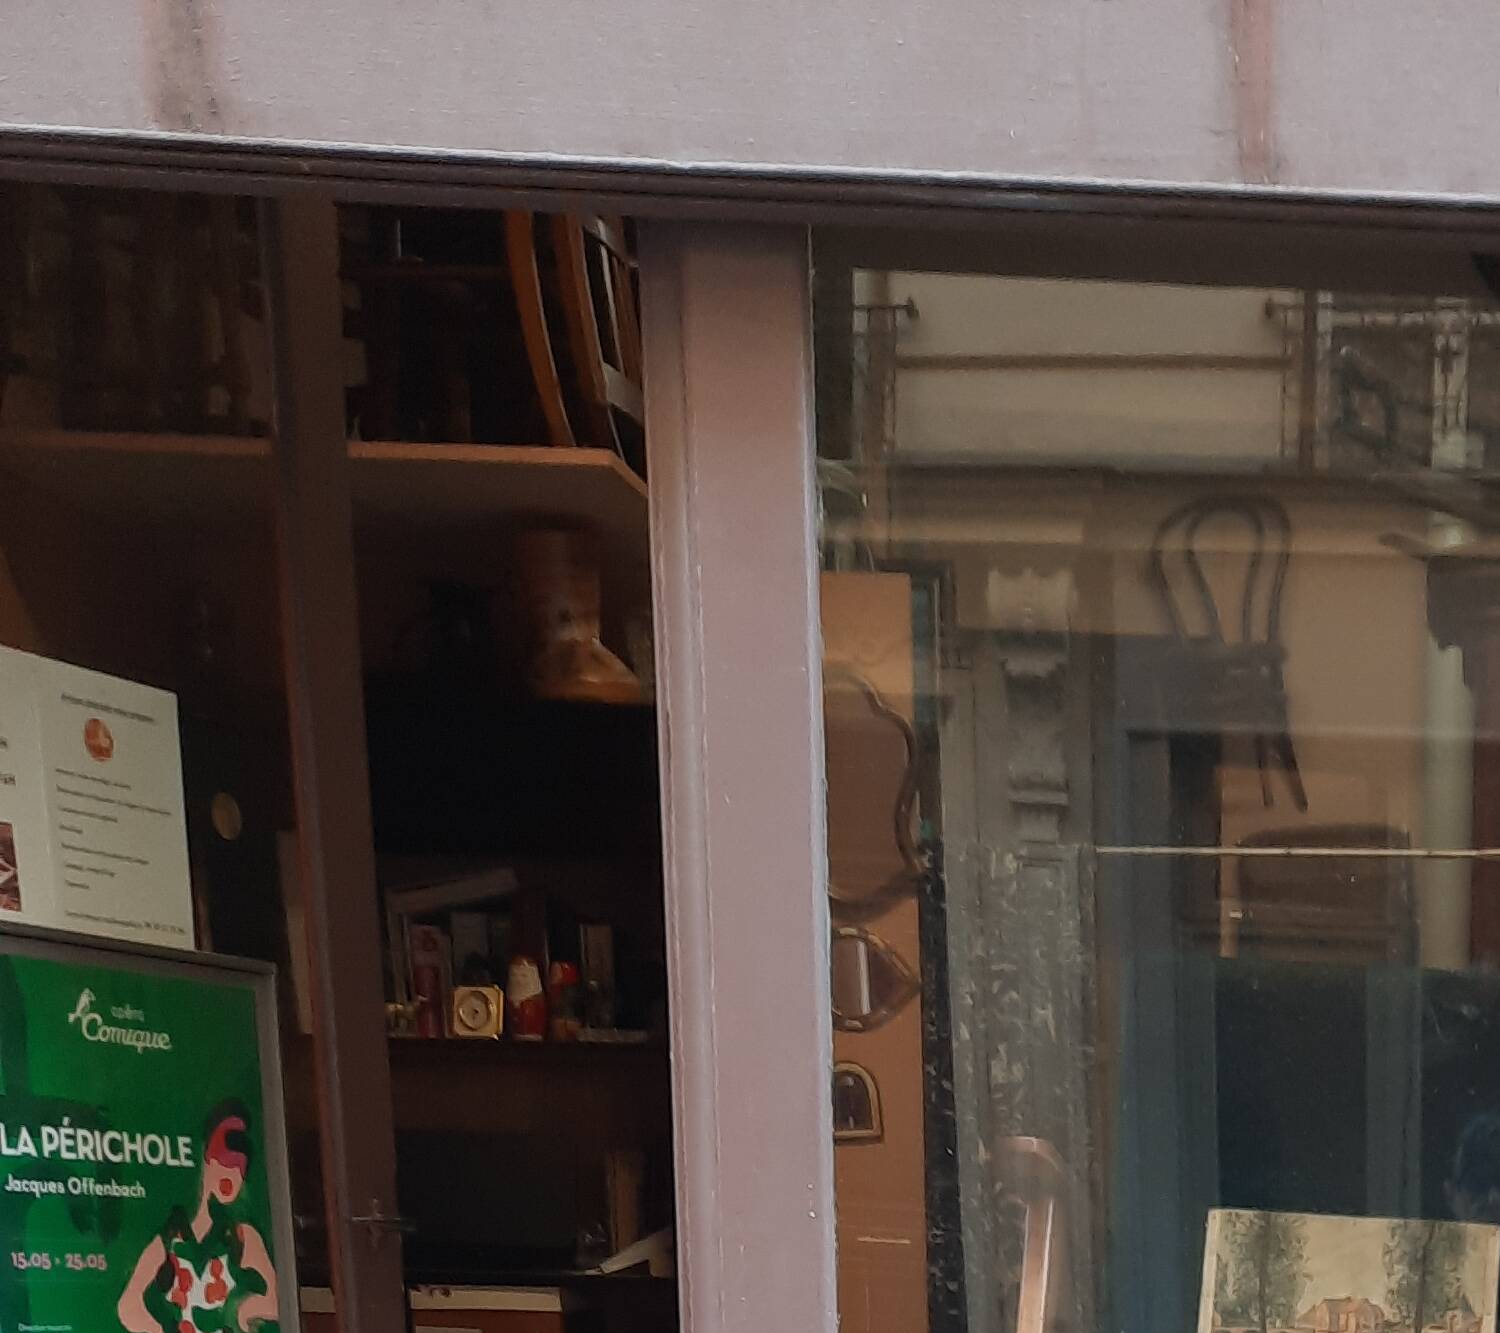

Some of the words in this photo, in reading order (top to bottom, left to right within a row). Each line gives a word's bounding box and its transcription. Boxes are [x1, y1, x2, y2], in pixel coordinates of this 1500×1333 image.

[81, 1012, 172, 1055] Comique
[0, 1121, 38, 1158] LA
[40, 1116, 195, 1168] PÉRICHOLE
[5, 1173, 65, 1199] Jacques
[67, 1176, 147, 1199] Offenbach
